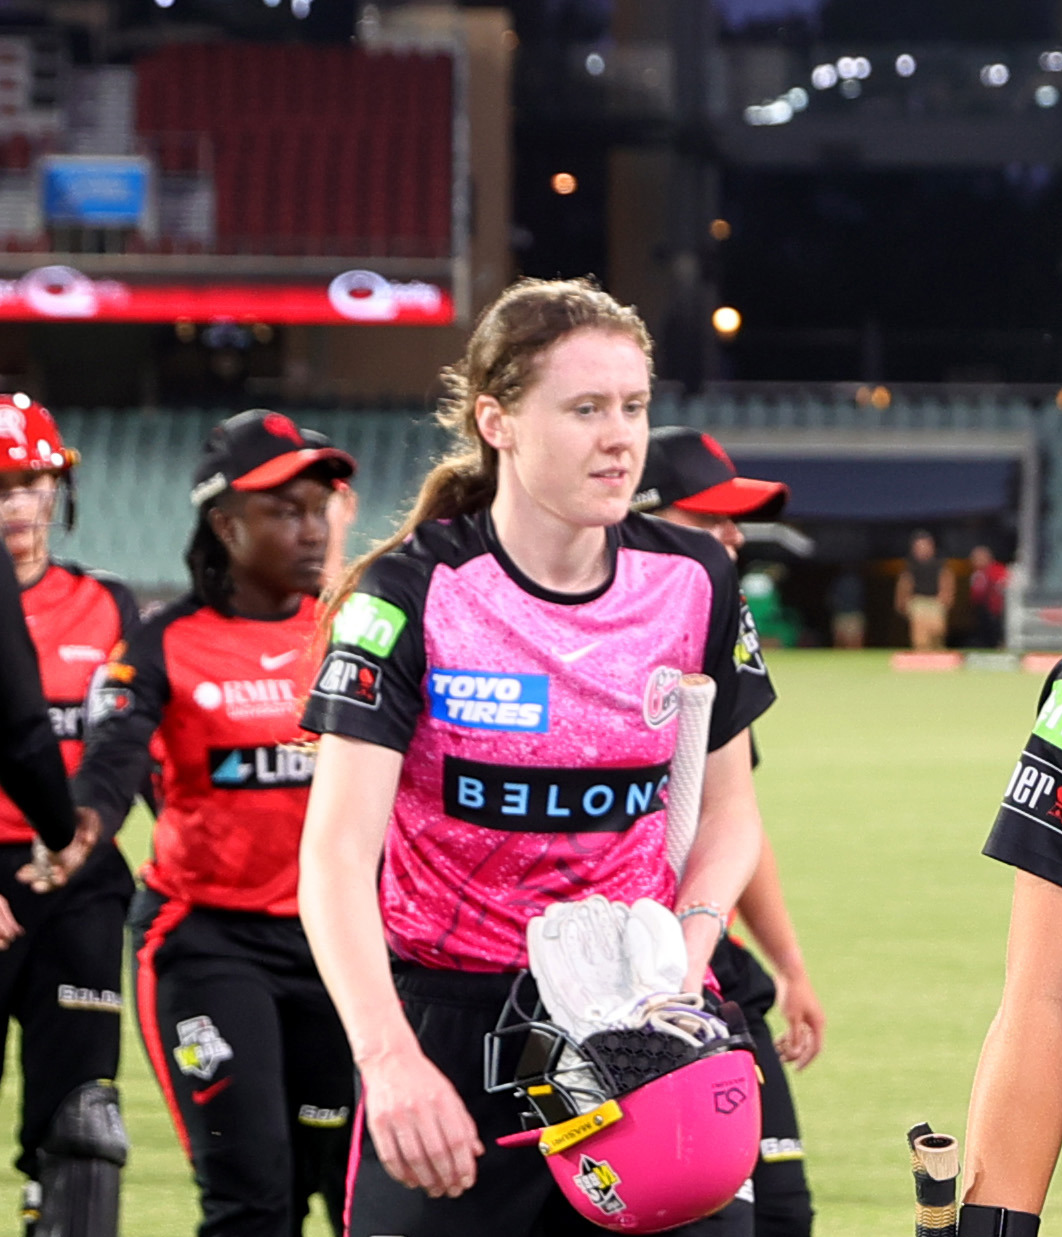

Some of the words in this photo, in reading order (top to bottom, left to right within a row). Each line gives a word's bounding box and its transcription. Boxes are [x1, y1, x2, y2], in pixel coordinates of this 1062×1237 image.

[432, 673, 521, 700] TOYO
[446, 698, 543, 727] TIRES
[458, 774, 669, 817] BELON
